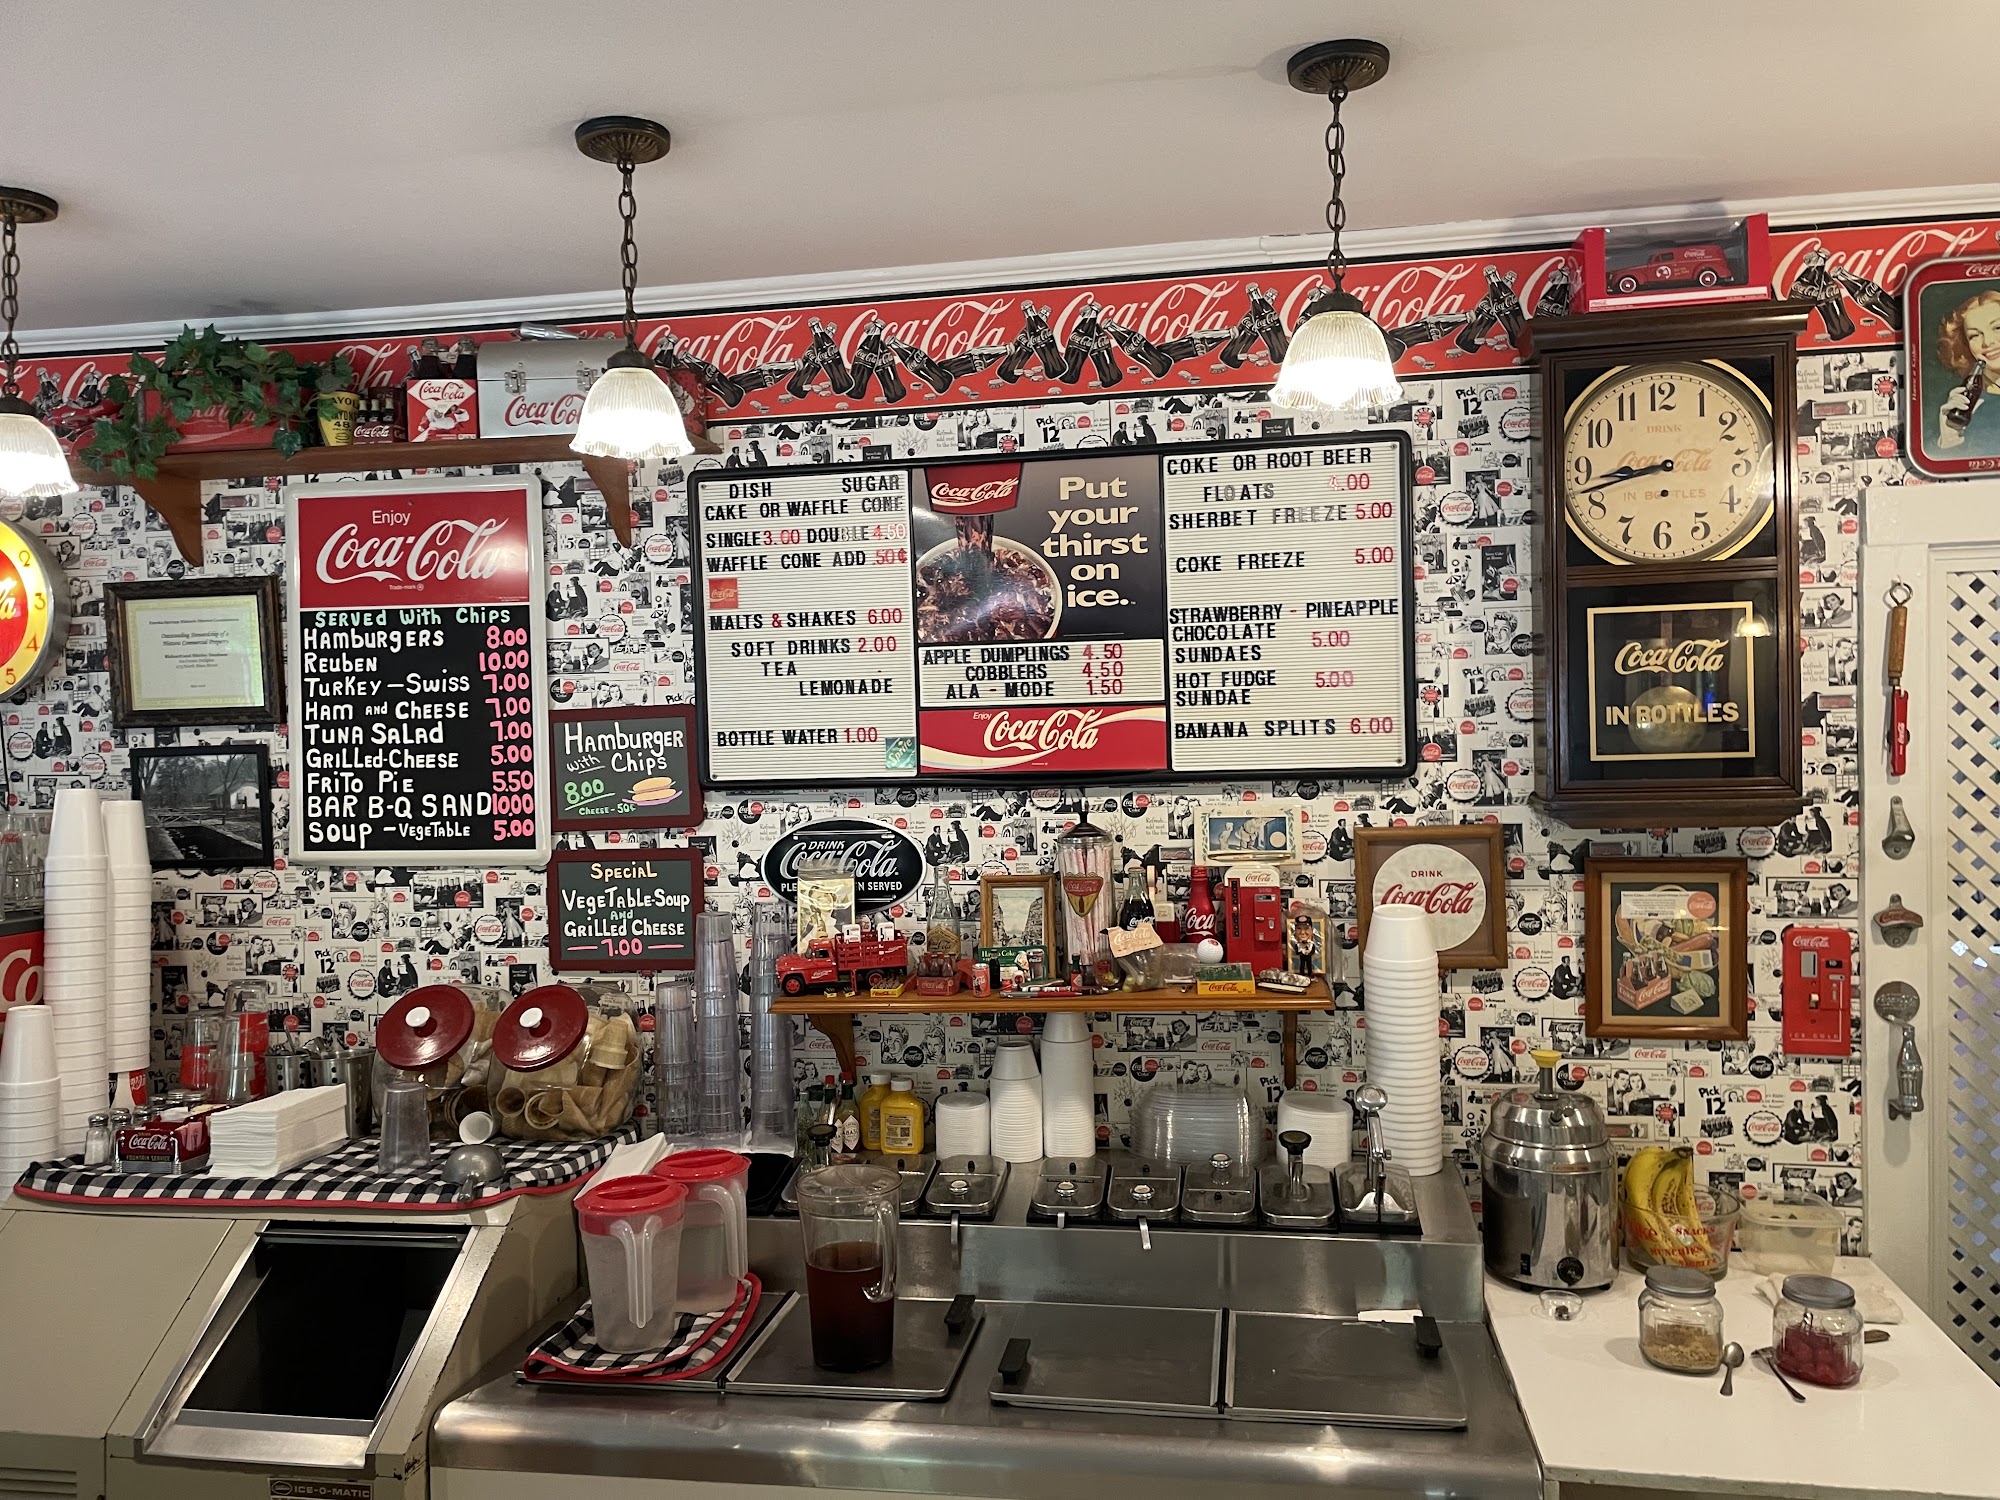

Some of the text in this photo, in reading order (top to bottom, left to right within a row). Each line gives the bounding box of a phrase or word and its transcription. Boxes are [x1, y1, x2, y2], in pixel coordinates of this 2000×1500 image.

[419, 381, 469, 401] Coca-Cola
[1649, 382, 1677, 412] 12
[1618, 392, 1635, 421] 11
[1698, 388, 1705, 417] 1
[1587, 418, 1613, 448] 10
[1647, 425, 1681, 433] DRINK
[1718, 411, 1737, 442] 2
[1167, 448, 1371, 475] COKE OR ROOT BEER
[1575, 456, 1592, 485] 9
[1732, 449, 1752, 477] 3
[729, 475, 900, 498] DISH SUGAR
[931, 477, 1018, 503] Coca-Cola
[1060, 477, 1127, 500] Put
[1203, 473, 1370, 502] FLOATS 4.00
[1624, 492, 1636, 501] IN
[705, 496, 903, 520] CAKE OR WAFFLE CONE
[1588, 491, 1607, 520] 8
[1719, 485, 1741, 513] 4
[372, 510, 411, 526] Enjoy
[1048, 506, 1139, 533] your
[1169, 502, 1392, 530] SHERBET FREEZE 5.00
[1691, 512, 1711, 540] 5
[707, 524, 907, 548] SINGLE 3.00 DOUBLE 4.50
[1618, 516, 1635, 544] 7
[1653, 521, 1672, 550] 6
[316, 517, 509, 584] Coca-Cola
[1040, 533, 1148, 557] thirst
[707, 555, 768, 572] WAFFLE
[781, 553, 821, 569] CONE
[833, 551, 865, 566] ADD
[1176, 546, 1393, 573] COKE FREEZE 5.00
[1071, 563, 1119, 580] on
[1067, 585, 1129, 608] ice.
[710, 608, 902, 630] MALTS & SHAKES 6.00
[1169, 599, 1398, 624] STRAWBERRY PINEAPPLE
[487, 625, 527, 649] 8.00
[1173, 623, 1350, 647] CHOCOLATE 5.00
[731, 636, 897, 657] SOFT DRINKS 2.00
[924, 644, 1122, 665] APPLE DUMPLINGS 4.50
[1175, 645, 1261, 663] SUNDAES
[1615, 639, 1729, 675] Coca-Cola
[479, 650, 529, 671] 10.00
[762, 661, 797, 676] TEA
[966, 661, 1123, 681] COBBLERS 4.50
[6, 669, 17, 685] 5
[483, 673, 529, 694] 7.00
[800, 679, 893, 696] LEMONADE
[1176, 670, 1354, 688] HOT FUDGE 5.00
[946, 680, 1122, 699] ALA MODE 1.50
[1176, 689, 1250, 706] SUNDAE
[485, 697, 530, 718] 7.00
[973, 712, 992, 720] Enjoy
[1606, 702, 1739, 725] IN BOTTLES
[490, 721, 532, 741] 7.00
[717, 727, 878, 746] BOTTLE WATER 1.00
[984, 709, 1103, 751] Coca-Cola
[1175, 717, 1393, 739] BANANA SPLITS 6.00
[491, 745, 532, 765] 5.00
[611, 752, 667, 775] Chips
[888, 738, 913, 767] Sprite
[492, 770, 533, 792] 5.50
[564, 779, 604, 804] 8.00
[308, 792, 534, 819] BAR B-Q SAND 10.00
[494, 819, 534, 841] 5.00
[808, 841, 845, 850] DRINK
[1245, 873, 1271, 883] Coca-Cola
[1411, 870, 1443, 878] DRINK
[868, 881, 902, 891] SERVED
[1381, 882, 1479, 914] Coca-Cola
[601, 938, 642, 956] 7.00
[1793, 936, 1829, 948] Coca-Cola
[1209, 983, 1238, 991] Coca-Cola
[1699, 1086, 1719, 1098] Pick
[129, 1134, 170, 1150] Coca-Cola
[295, 1486, 370, 1498] ICE-O-MATIC
